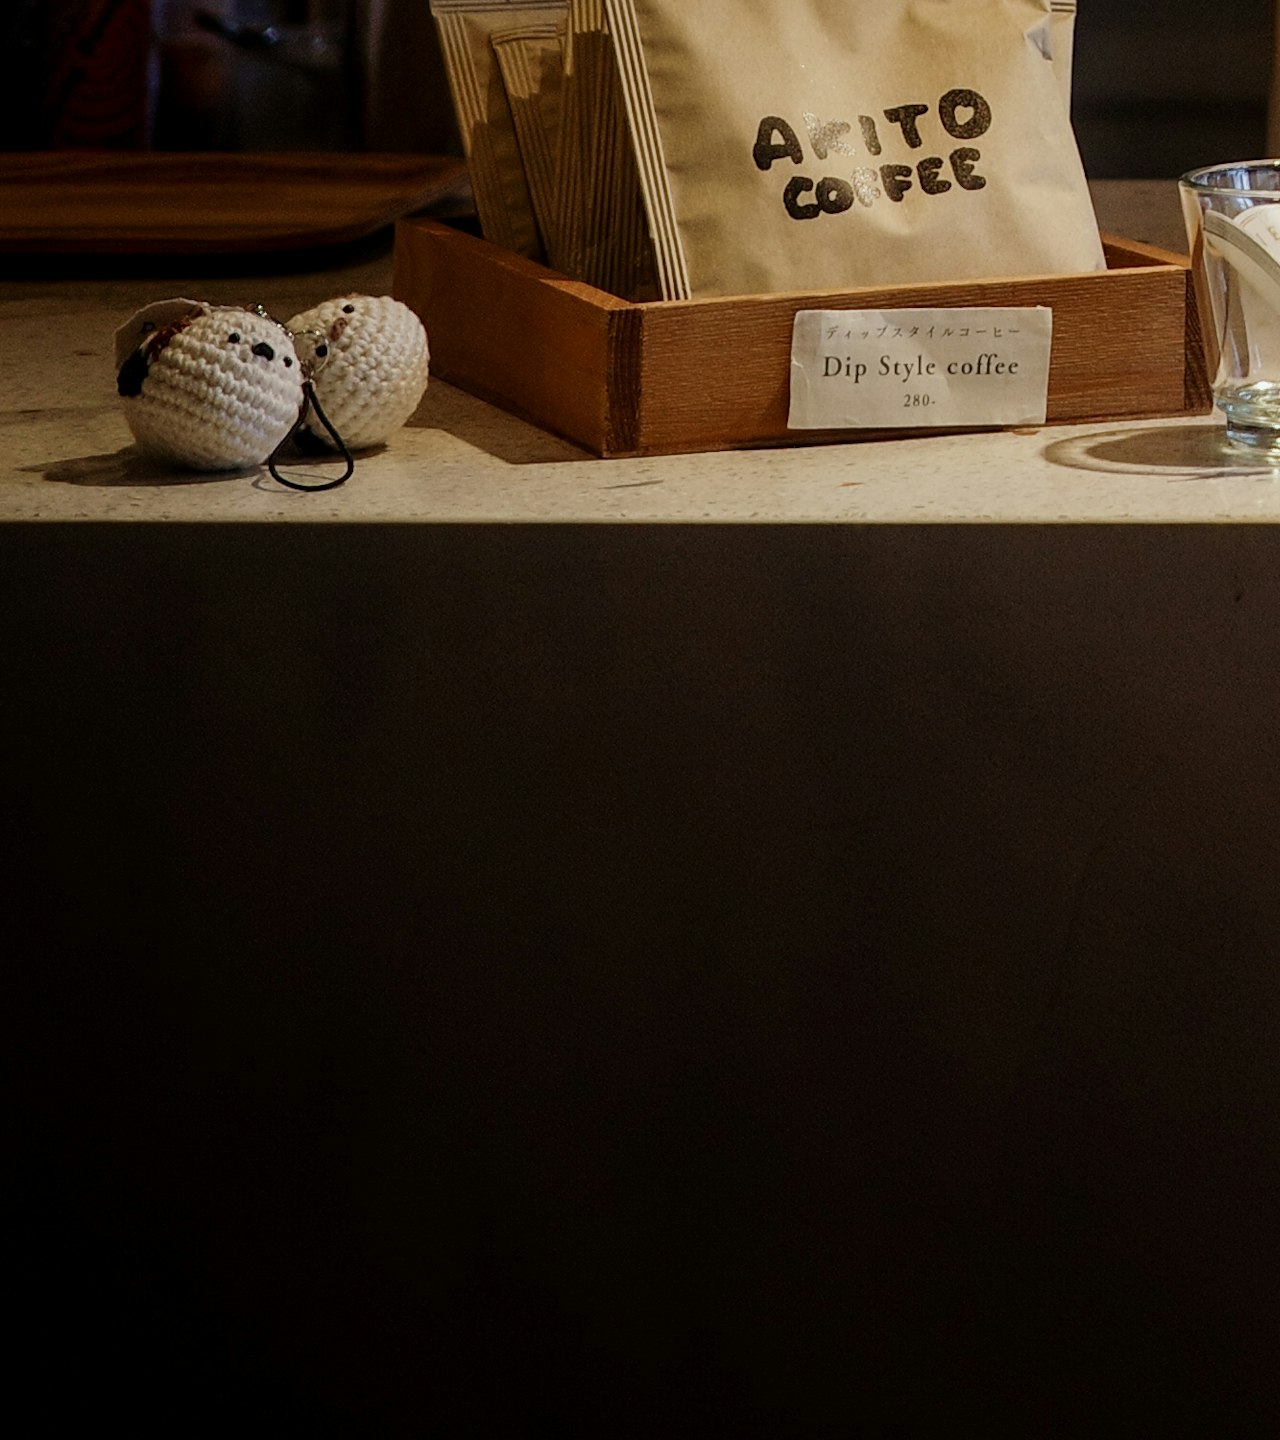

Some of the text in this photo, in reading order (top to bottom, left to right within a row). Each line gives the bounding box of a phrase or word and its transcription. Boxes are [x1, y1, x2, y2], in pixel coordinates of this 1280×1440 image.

[753, 89, 992, 171] AKITO
[783, 147, 987, 220] COFFEE
[826, 325, 1021, 340] ディップスタイルコーヒー
[823, 353, 1019, 383] Dip Style coffee
[903, 394, 936, 407] 280-
